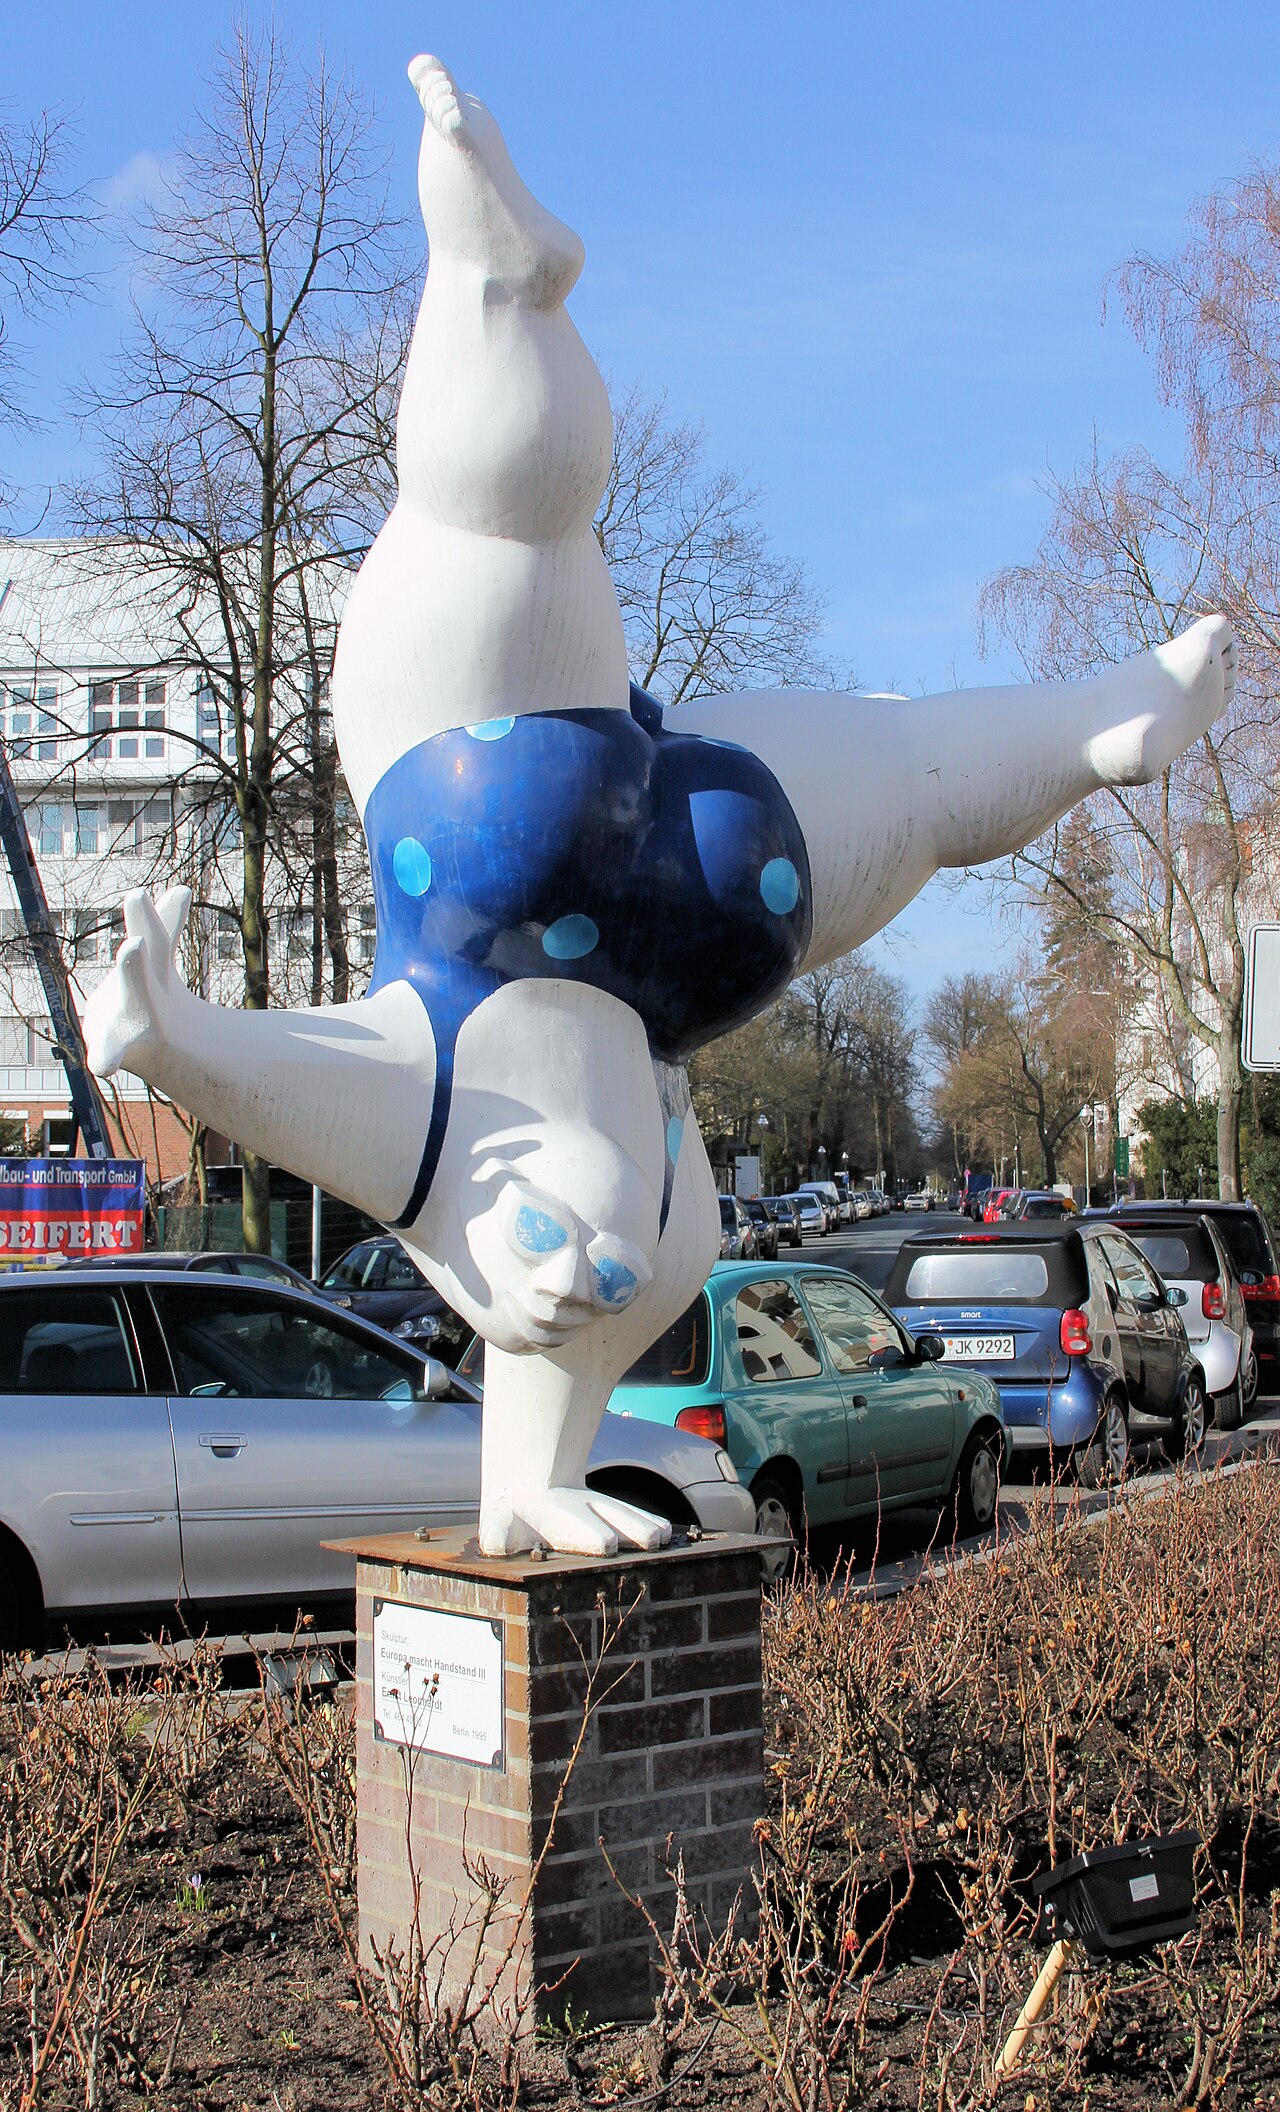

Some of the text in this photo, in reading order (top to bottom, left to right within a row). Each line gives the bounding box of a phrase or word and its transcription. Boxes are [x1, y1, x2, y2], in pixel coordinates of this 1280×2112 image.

[32, 1166, 54, 1184] und
[55, 1167, 107, 1188] Transport
[108, 1170, 137, 1184] GmbH
[955, 1339, 1012, 1355] JK 9292
[380, 1647, 486, 1680] Europa macht Handstand III
[403, 1691, 443, 1711] Lonhardt
[452, 1724, 487, 1742] Berlin 1995
